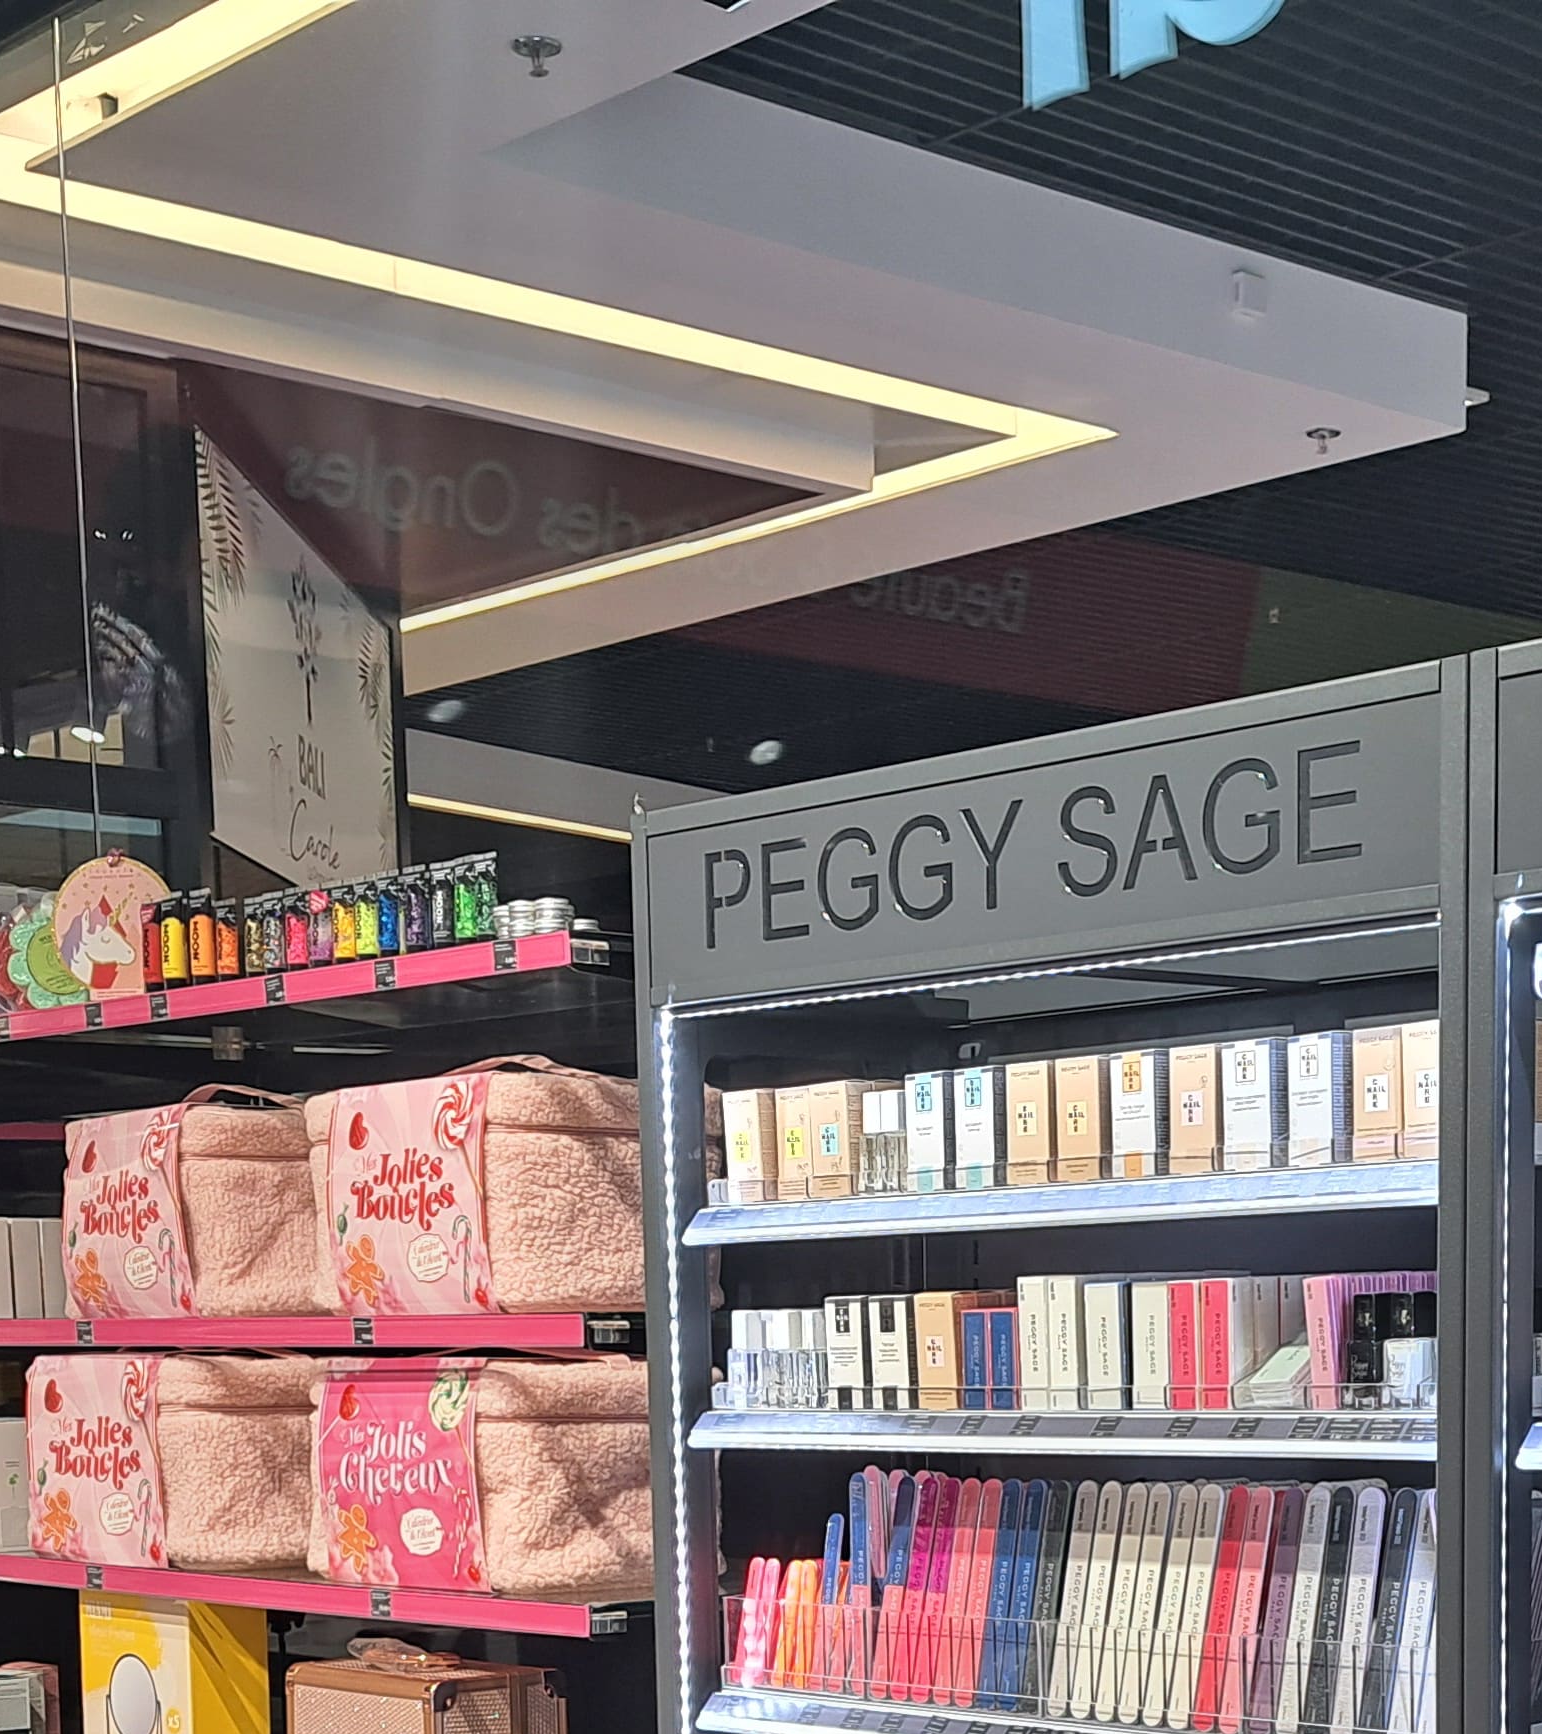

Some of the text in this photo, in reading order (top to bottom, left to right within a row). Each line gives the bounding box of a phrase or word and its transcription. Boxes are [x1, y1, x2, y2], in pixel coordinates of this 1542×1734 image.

[298, 734, 326, 800] BALI
[704, 741, 1363, 949] PEGGY SAGE
[161, 922, 171, 965] MOON
[192, 918, 202, 963] MOON
[96, 1172, 150, 1208] Jolies
[372, 1147, 443, 1194] Jolies
[79, 1198, 159, 1243] Boucles
[349, 1179, 456, 1231] Boucles
[1030, 1314, 1039, 1373] PEGGY SAGE
[1060, 1313, 1069, 1373] PEGGY SAGE
[1102, 1350, 1110, 1376] SAGE
[1182, 1350, 1190, 1376] SAGE
[1214, 1313, 1223, 1375] PEGGY SAGE
[69, 1415, 134, 1458] Jolies
[363, 1419, 427, 1464] Jolis
[48, 1440, 142, 1489] Boucles
[339, 1452, 454, 1506] Cheveux
[167, 1714, 180, 1728] x5
